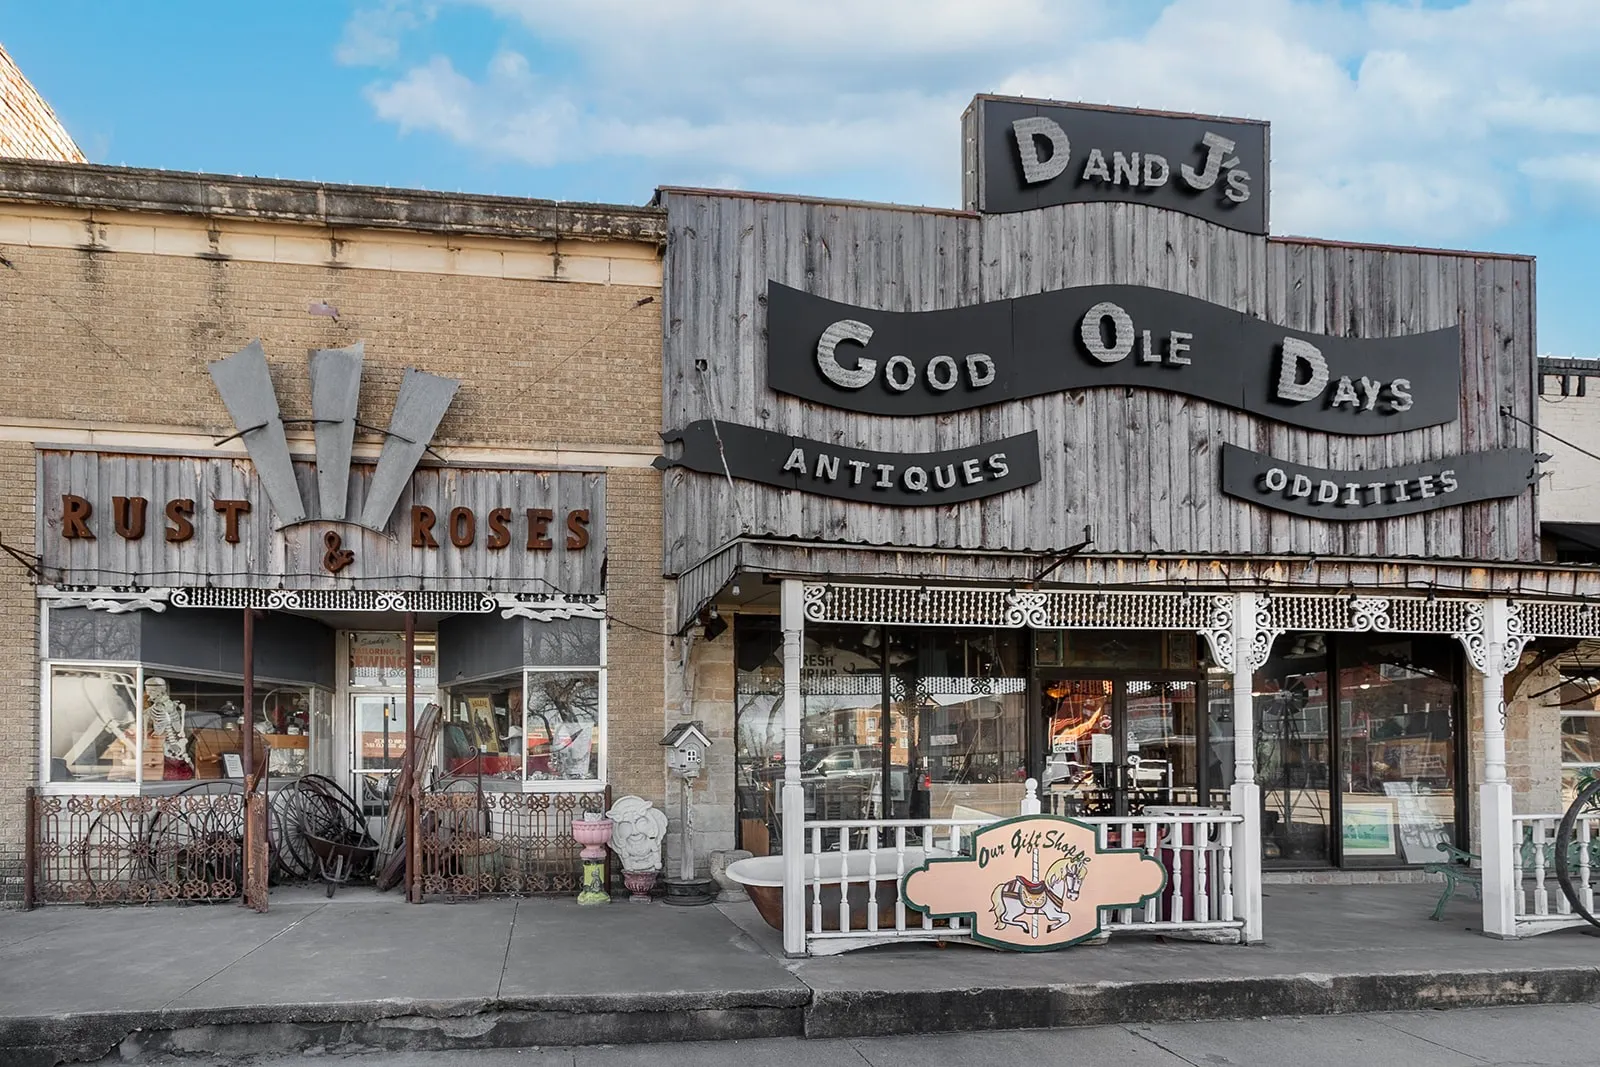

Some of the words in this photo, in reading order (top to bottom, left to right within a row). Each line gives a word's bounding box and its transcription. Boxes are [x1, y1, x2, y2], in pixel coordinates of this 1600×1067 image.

[1011, 117, 1071, 184] D
[1082, 148, 1170, 187] AND
[816, 319, 996, 392] GOOD
[1080, 302, 1193, 367] OLE
[1276, 336, 1413, 412] DAYS
[783, 448, 1009, 493] ANTIQUES
[1264, 467, 1458, 506] ODDITIES
[61, 494, 252, 543] RUST
[323, 530, 355, 573] &
[411, 505, 590, 550] ROSES
[800, 668, 837, 680] HRIMP
[803, 655, 834, 667] RESH
[978, 844, 1006, 869] Our
[1011, 828, 1042, 858] Gift
[1042, 830, 1092, 866] Shoppe
